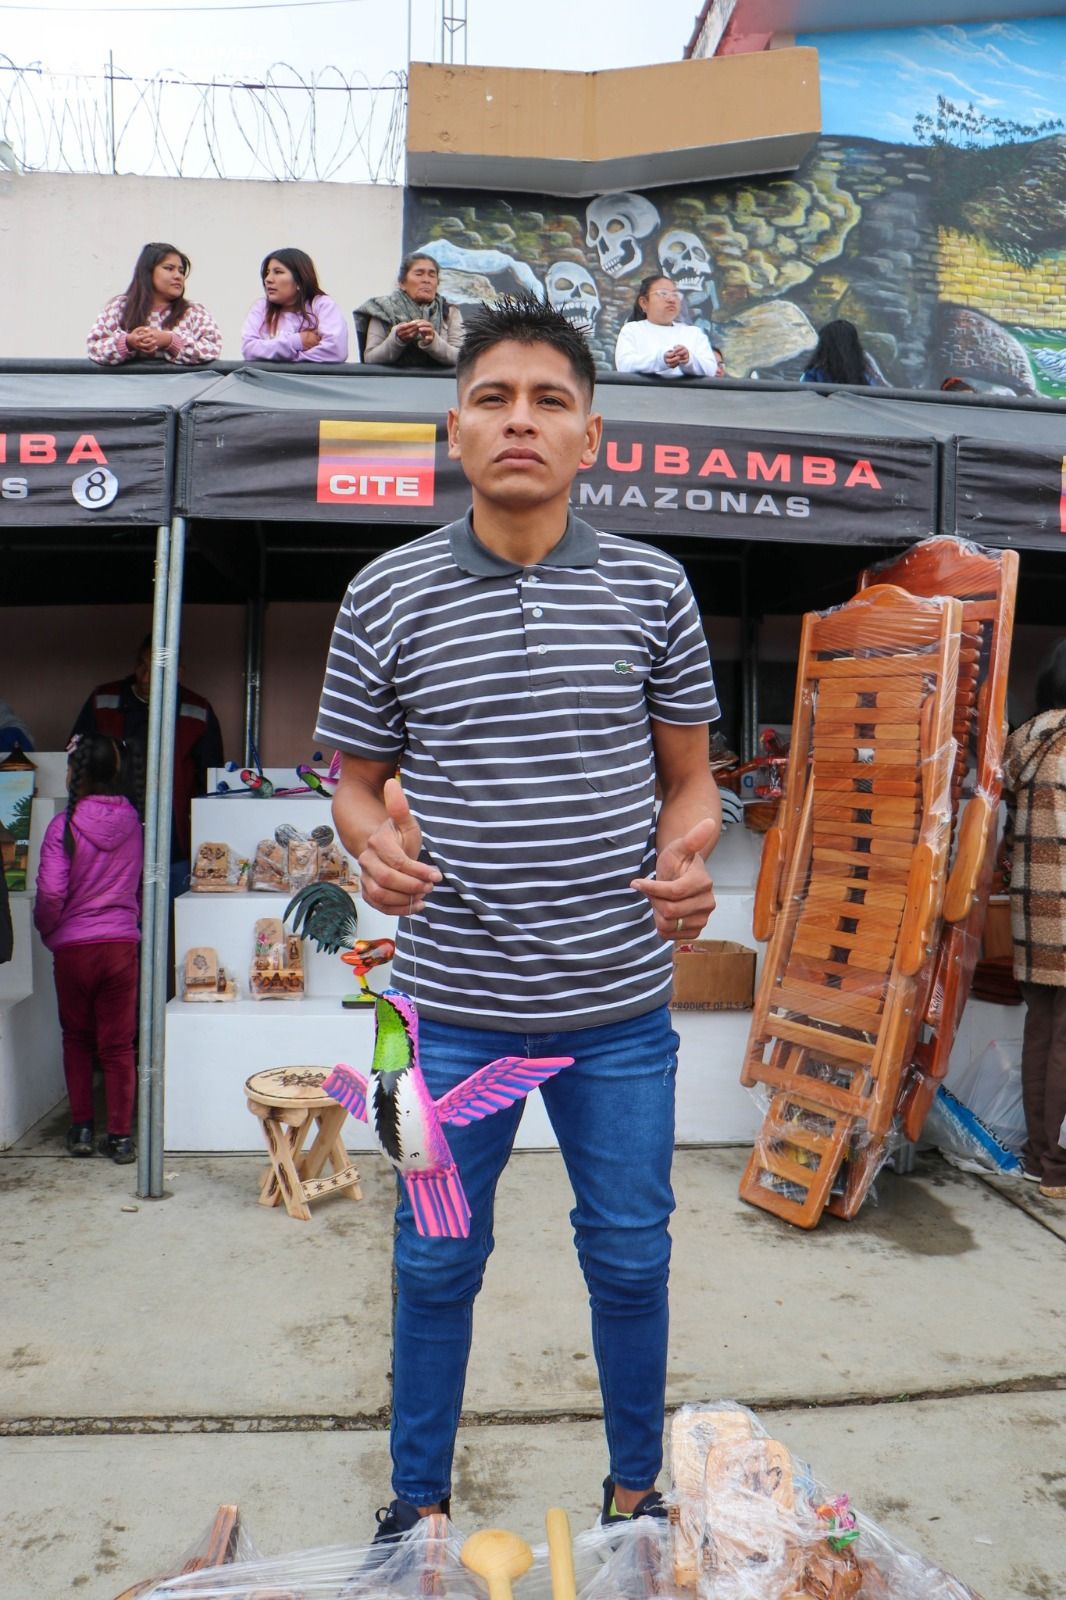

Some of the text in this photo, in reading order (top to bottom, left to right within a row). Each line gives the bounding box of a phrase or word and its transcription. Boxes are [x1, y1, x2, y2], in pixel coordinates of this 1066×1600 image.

[578, 441, 882, 490] UBAMBA
[85, 471, 106, 502] 8
[329, 474, 419, 497] CITE
[568, 483, 810, 518] MAZONAS
[672, 1001, 711, 1010] PRODUCT
